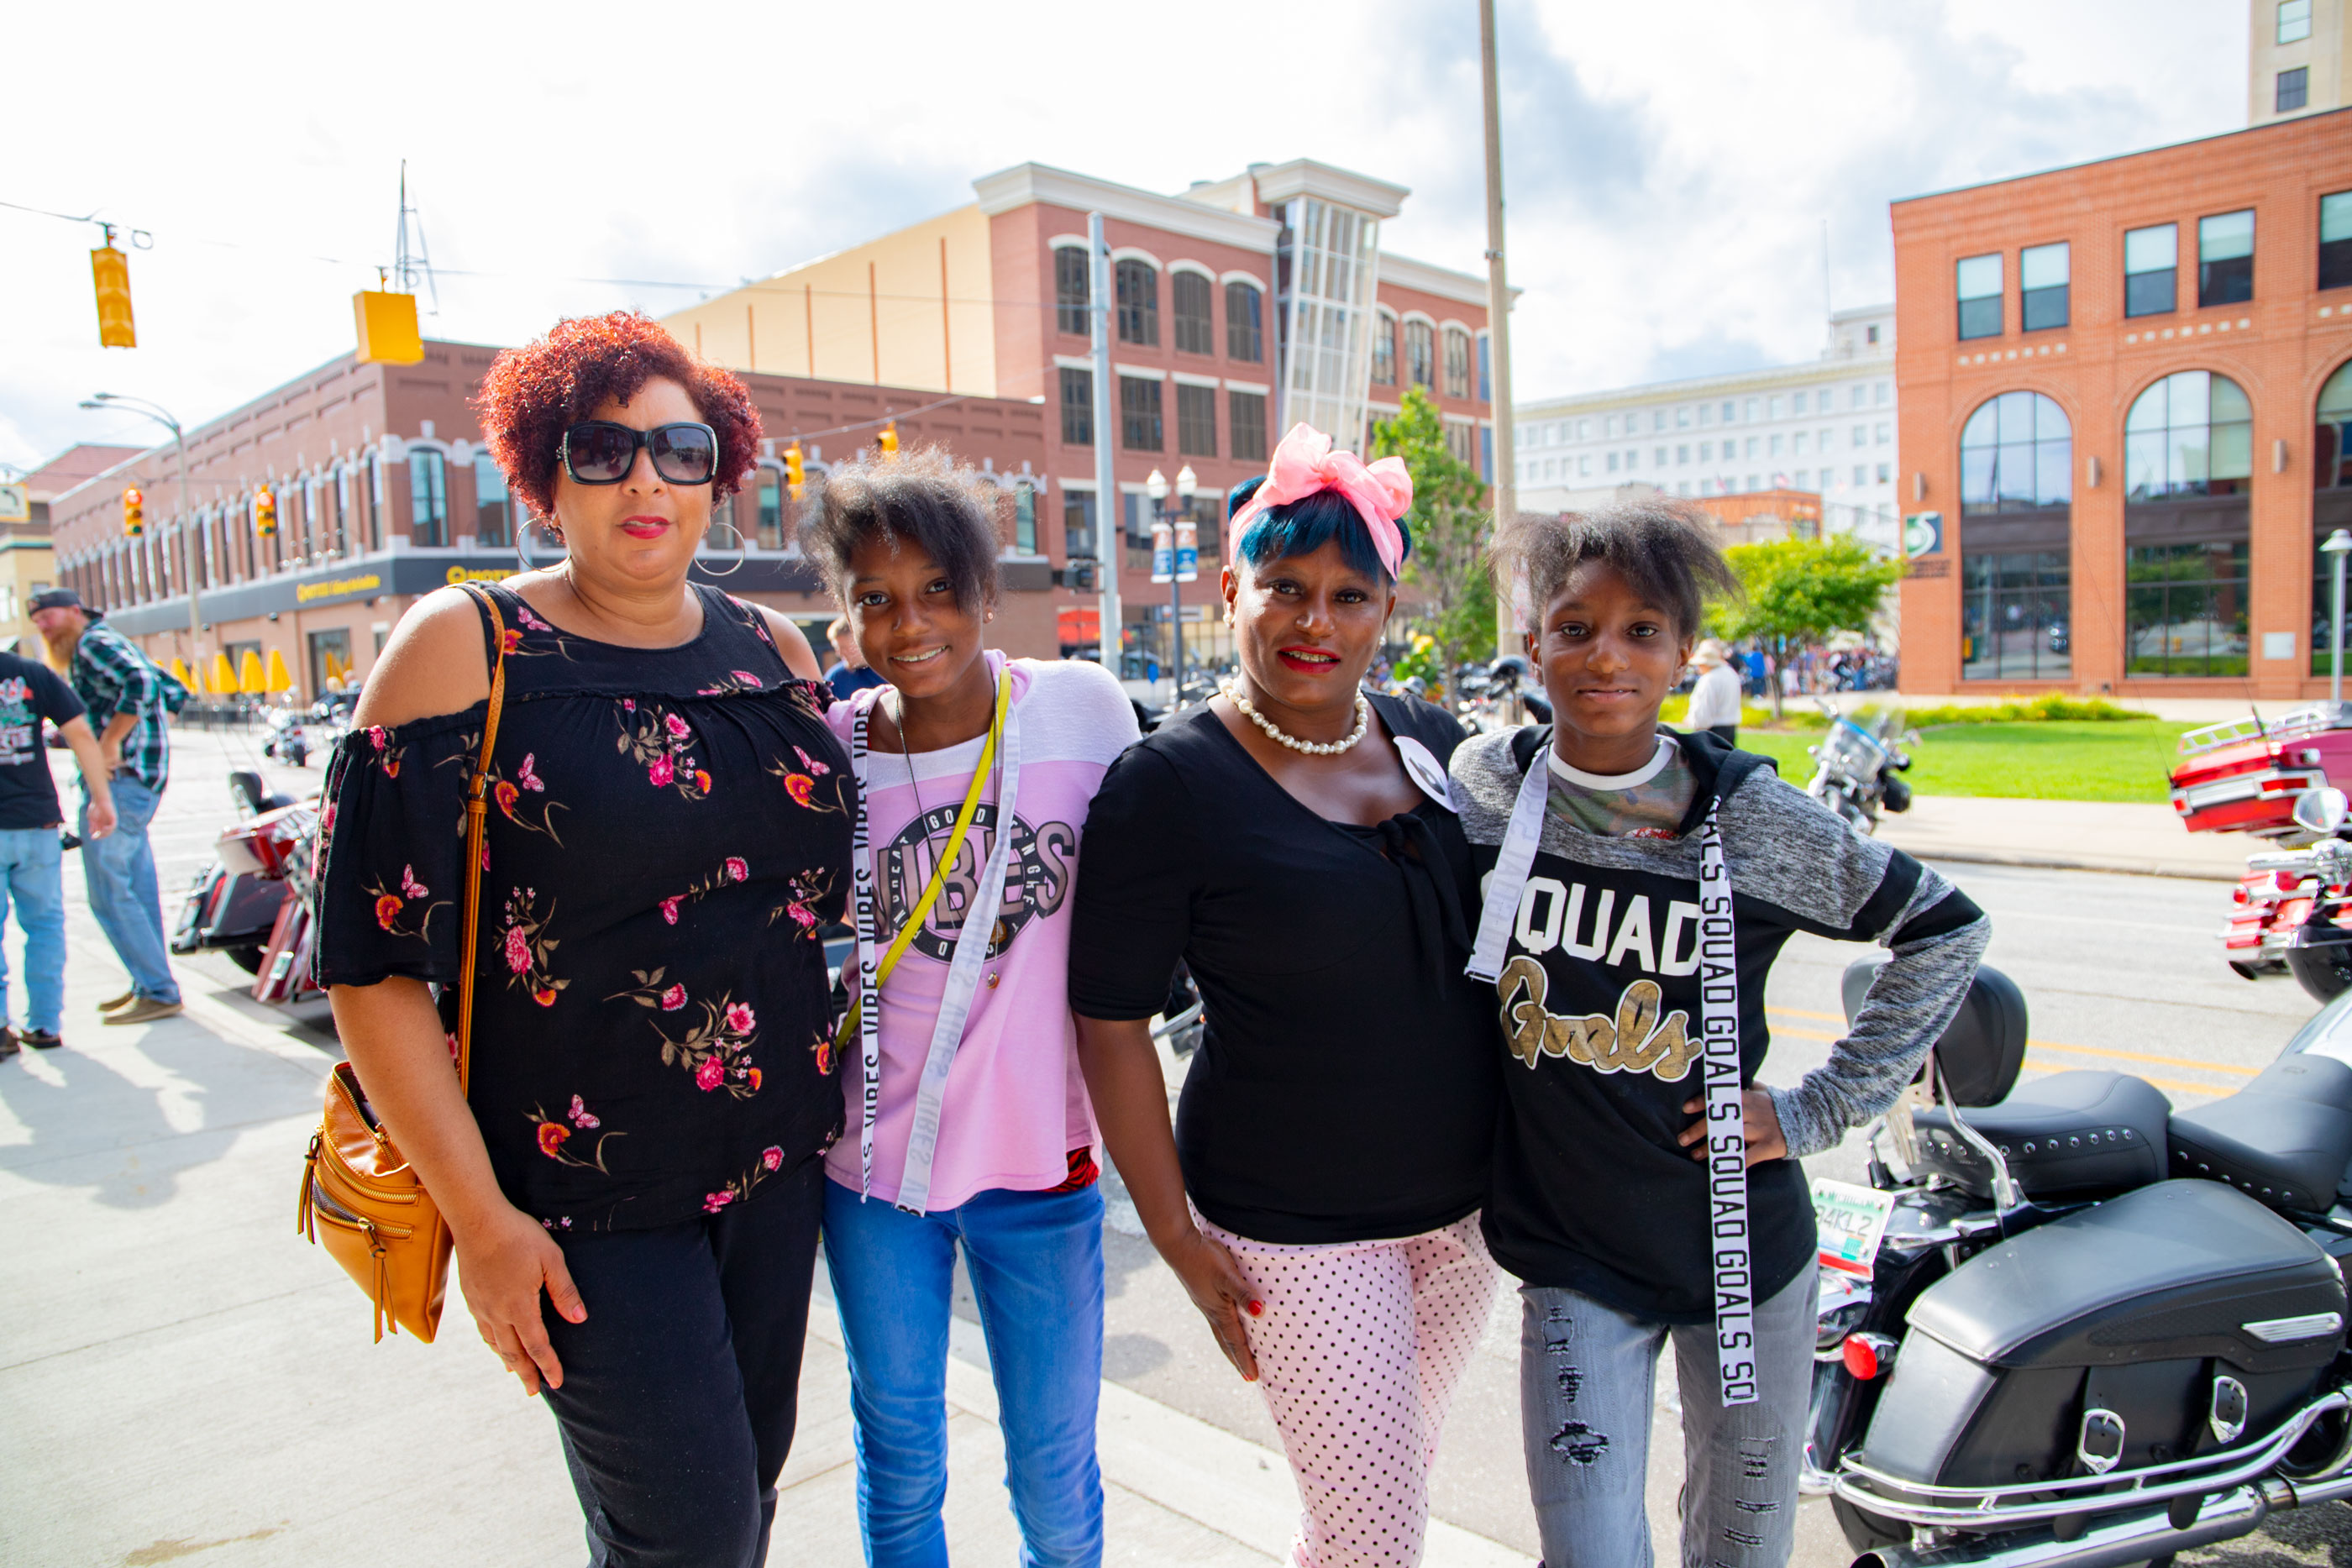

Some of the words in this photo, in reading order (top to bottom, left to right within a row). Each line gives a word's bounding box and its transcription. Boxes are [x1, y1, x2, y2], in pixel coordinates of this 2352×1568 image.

[929, 808, 986, 830] GOD
[855, 868, 875, 942] VIBES
[874, 821, 1075, 944] VIBES
[862, 961, 878, 1035] VIBES
[1702, 896, 1735, 1004] SQUAD
[1497, 956, 1704, 1082] Goals
[1705, 1016, 1740, 1122] GOALS
[864, 1055, 879, 1128] VIBES
[1710, 1135, 1746, 1239] SQUAD
[1714, 1250, 1752, 1350] GOALS
